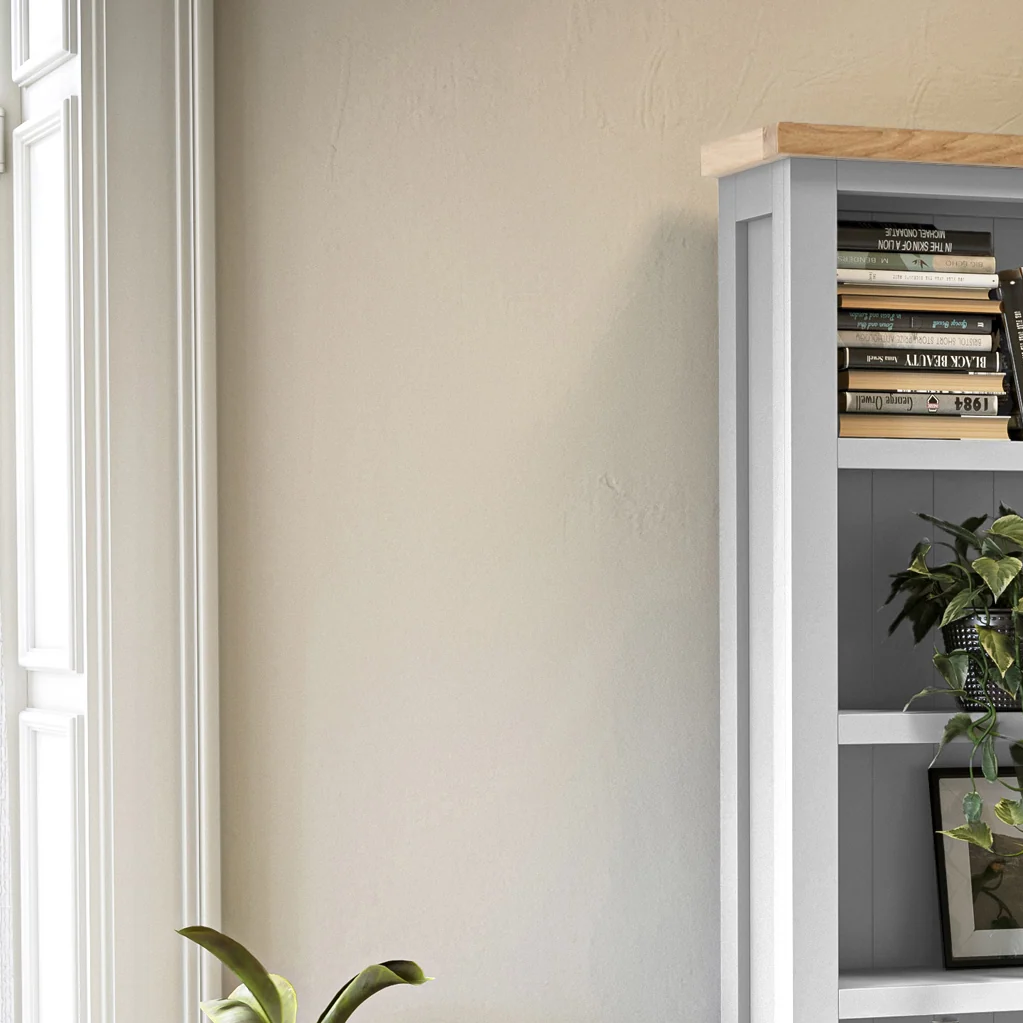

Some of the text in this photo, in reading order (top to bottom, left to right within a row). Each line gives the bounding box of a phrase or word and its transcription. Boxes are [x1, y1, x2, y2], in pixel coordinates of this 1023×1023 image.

[885, 228, 945, 239] MICHAEL ONDAATJE
[878, 240, 952, 252] IN THE SKIN OF A LION
[951, 319, 968, 328] George
[936, 337, 956, 345] SHORT
[958, 338, 981, 346] BRISTOL
[904, 354, 986, 368] BLACK BEAUTY
[856, 393, 913, 411] George Orwell
[954, 397, 989, 411] 1984
